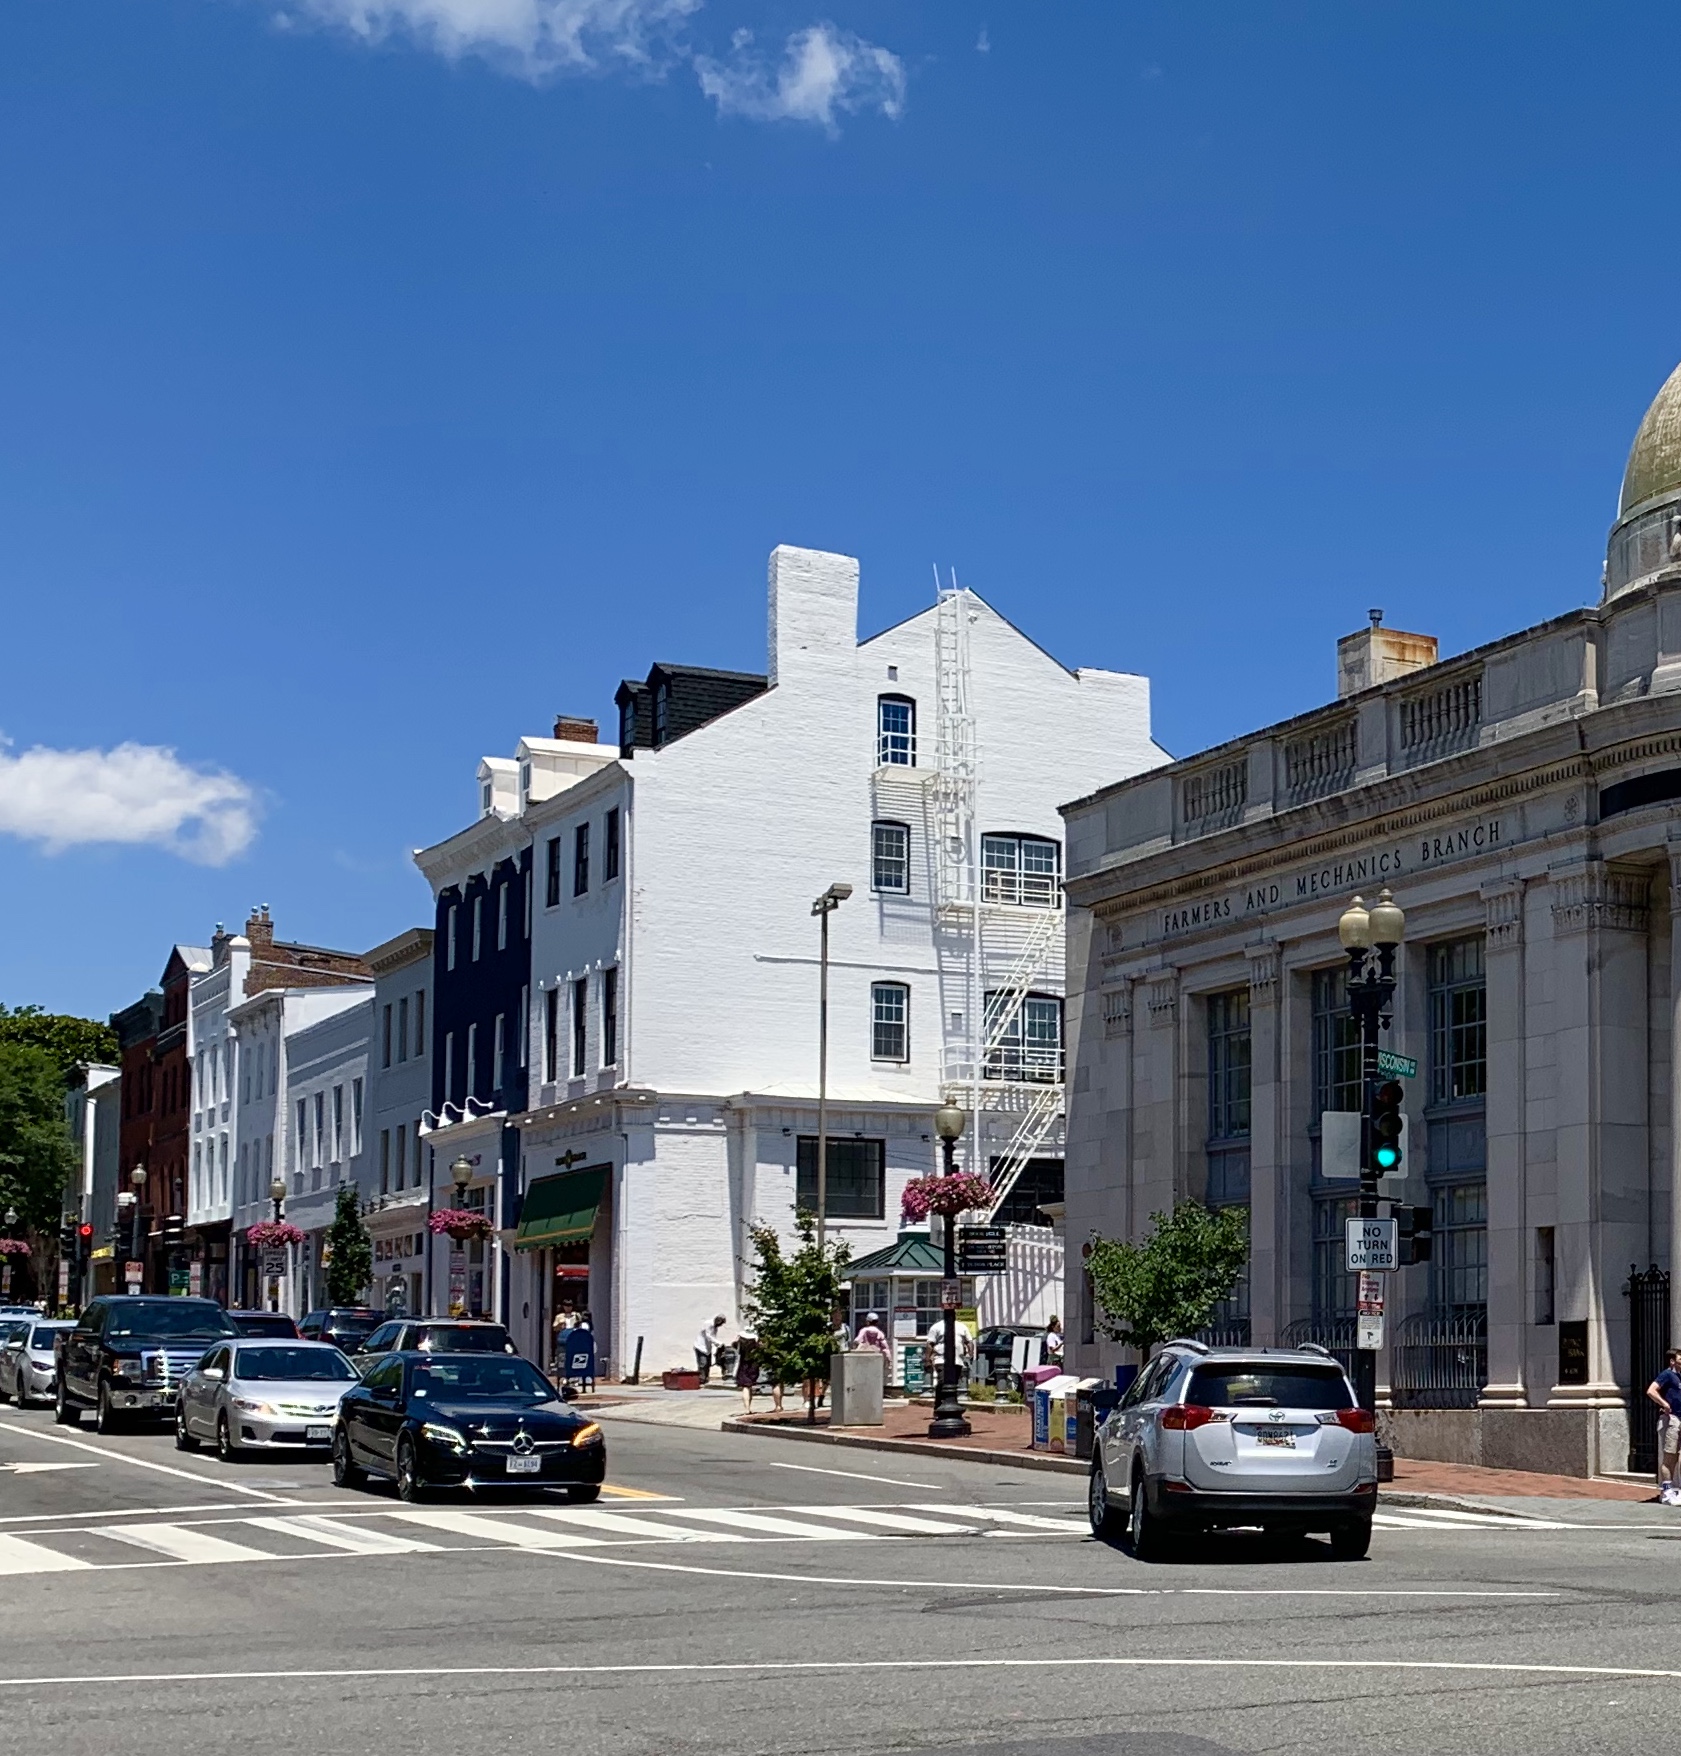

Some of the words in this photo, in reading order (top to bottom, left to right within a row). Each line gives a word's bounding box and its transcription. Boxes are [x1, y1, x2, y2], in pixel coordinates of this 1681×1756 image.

[1164, 897, 1231, 933] FARMERS
[1246, 885, 1279, 911] AND
[1296, 850, 1401, 896] MECHANICS
[1422, 821, 1500, 862] BRANCH
[1362, 1226, 1382, 1238] NO
[1356, 1240, 1388, 1251] TURN
[1350, 1253, 1367, 1264] ON
[1371, 1253, 1393, 1264] RED
[265, 1262, 285, 1274] 25
[171, 1273, 180, 1284] P
